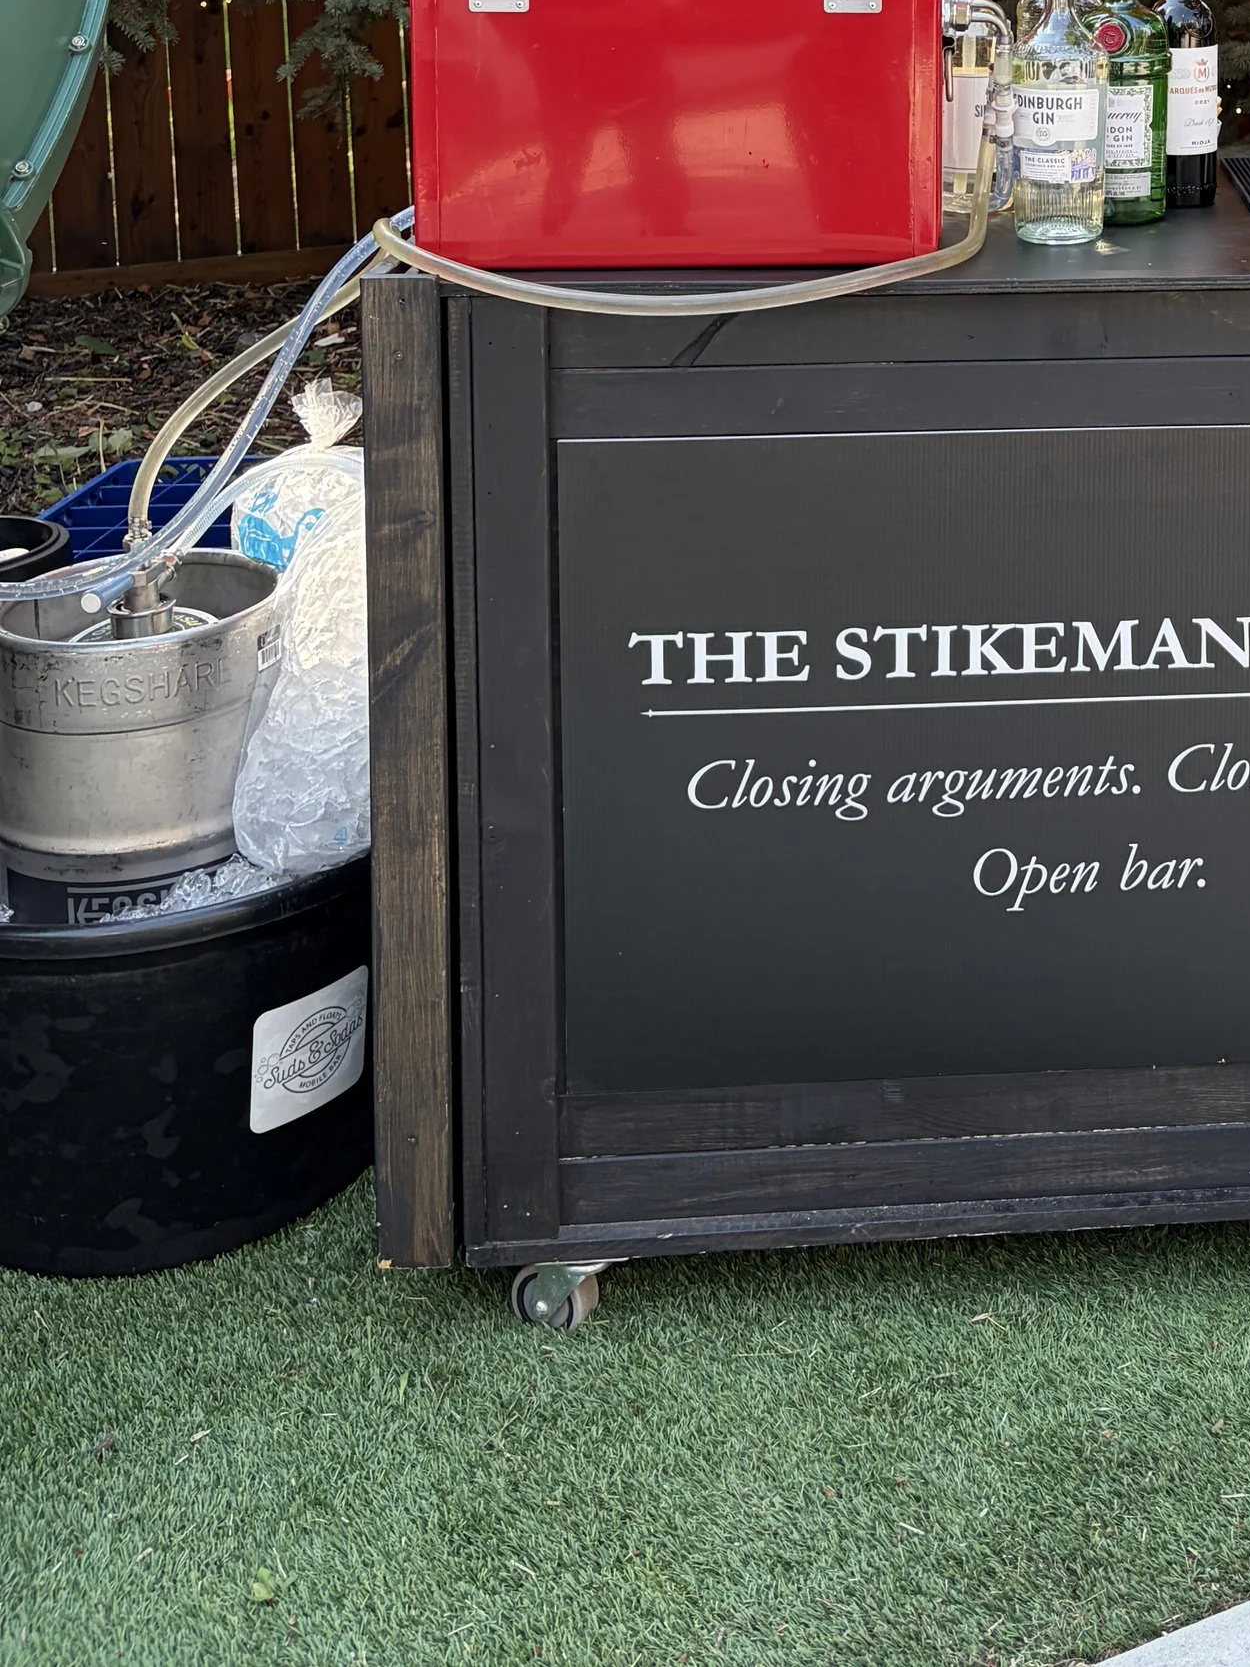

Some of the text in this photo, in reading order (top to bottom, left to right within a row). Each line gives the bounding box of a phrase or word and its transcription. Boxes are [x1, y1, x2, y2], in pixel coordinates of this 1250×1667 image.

[1168, 86, 1198, 94] ARQUÉS
[1032, 112, 1055, 125] GIN
[1107, 111, 1143, 123] ueray
[628, 631, 810, 684] THE
[687, 759, 871, 821] Closing
[886, 756, 1142, 817] arguments.
[973, 844, 1206, 912] Open bar.
[263, 1012, 363, 1090] Suds & Sodas
[285, 1011, 342, 1053] TAPS AND FLOATS
[298, 1053, 342, 1089] MOBILE BAR
